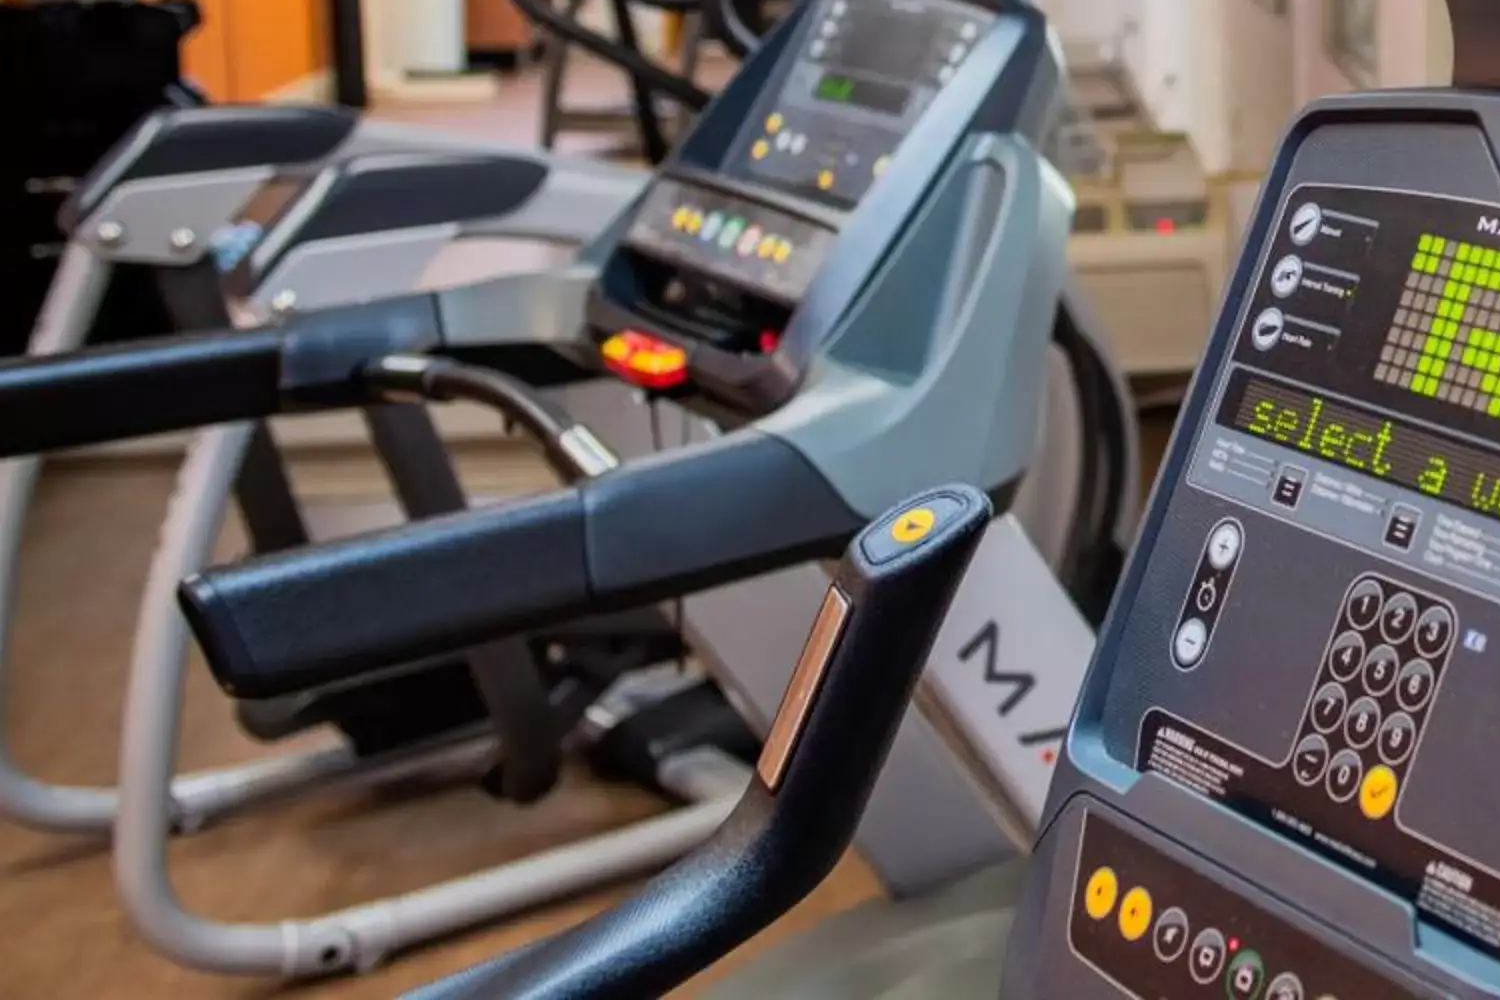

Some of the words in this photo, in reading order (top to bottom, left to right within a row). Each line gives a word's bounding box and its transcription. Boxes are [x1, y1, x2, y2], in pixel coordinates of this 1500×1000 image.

[1249, 398, 1392, 476] select
[1417, 455, 1448, 495] a
[1360, 595, 1370, 614] 1
[1391, 608, 1404, 629] 2
[1425, 621, 1439, 642] 3
[1341, 646, 1353, 666] 4
[1373, 660, 1386, 680] 5
[1408, 674, 1421, 695] 6
[1324, 697, 1335, 716] 7
[1356, 711, 1369, 732] 8
[1390, 727, 1402, 748] 9
[1337, 764, 1350, 786] 0
